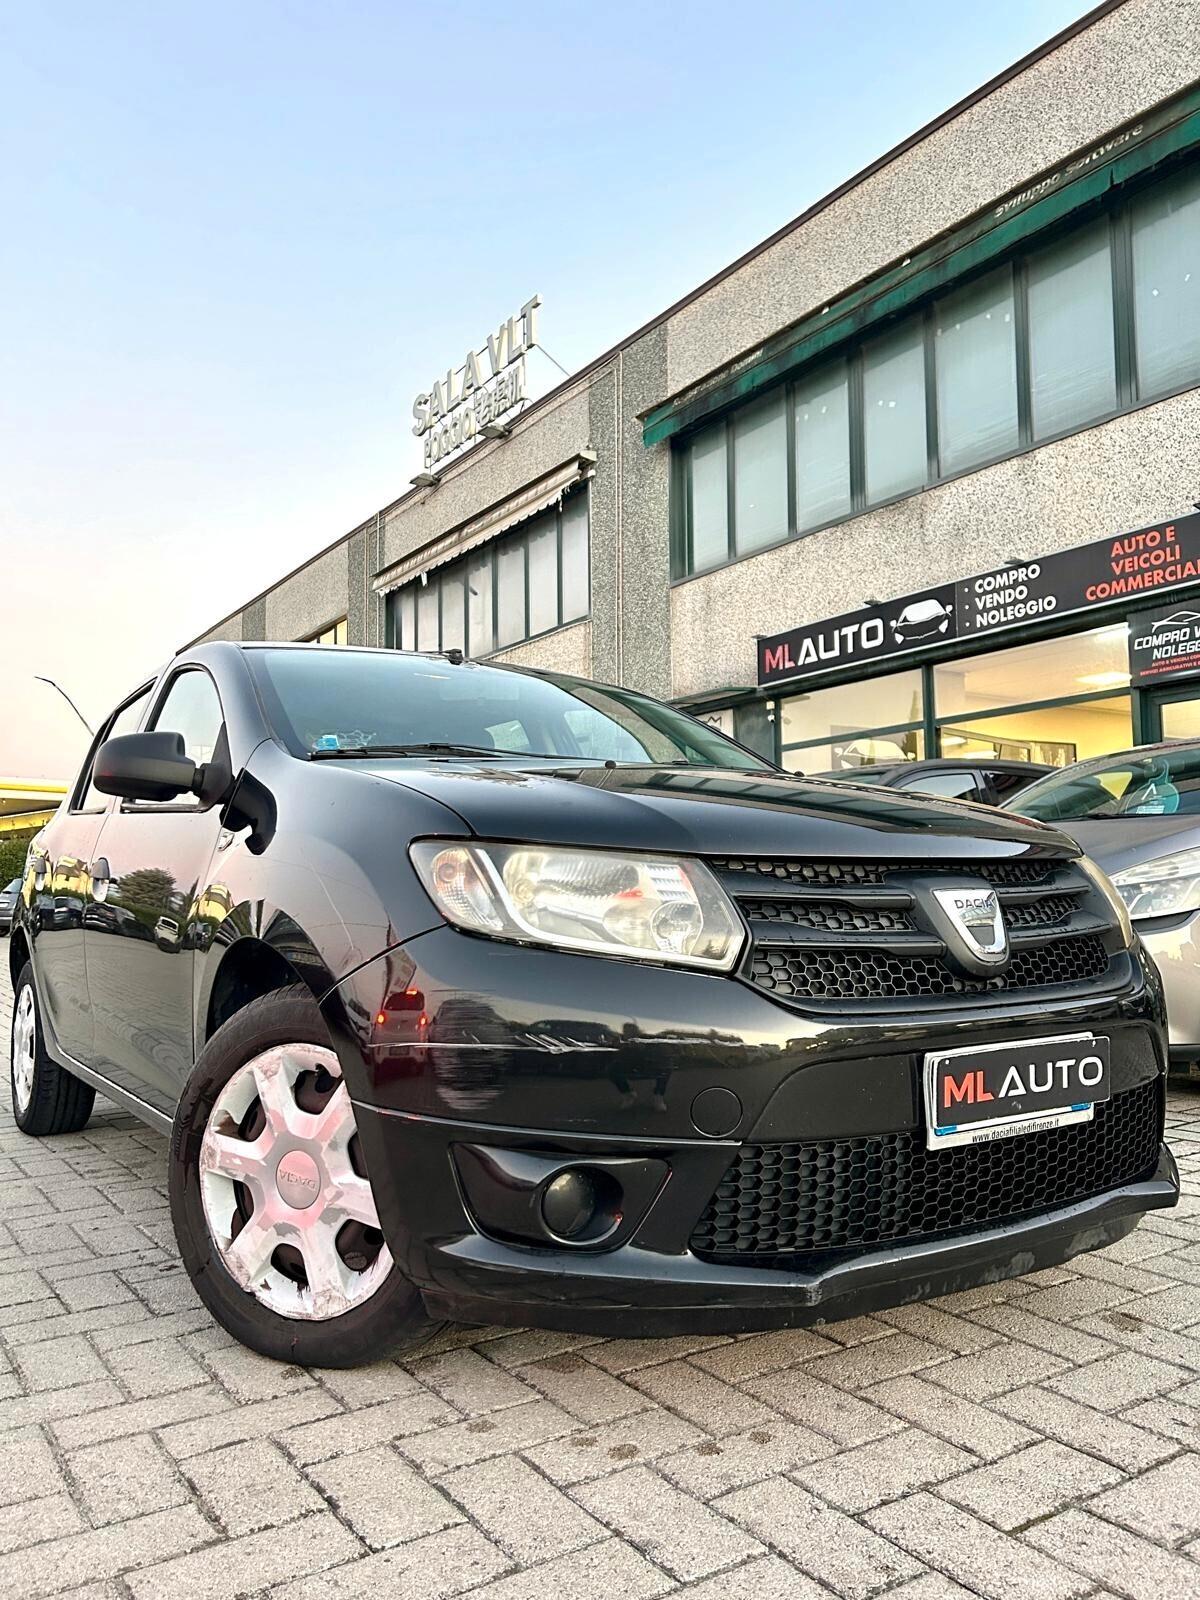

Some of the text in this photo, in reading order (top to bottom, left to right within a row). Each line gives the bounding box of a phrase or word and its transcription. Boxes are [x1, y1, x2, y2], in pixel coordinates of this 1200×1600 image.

[412, 294, 542, 437] SALA VLT
[1111, 526, 1176, 558] AUTO E
[1111, 545, 1181, 576] VEICOLI
[974, 564, 1041, 594] COMPRO
[975, 585, 1028, 611] VENDO
[976, 595, 1057, 628] NOLEGGIO
[798, 618, 884, 666] AUTO
[1134, 627, 1190, 650] COMPRO
[954, 898, 996, 909] DACIA
[943, 1056, 1103, 1108] ML AUTO
[971, 1118, 1059, 1143] www.daciafilialedifirenze.it
